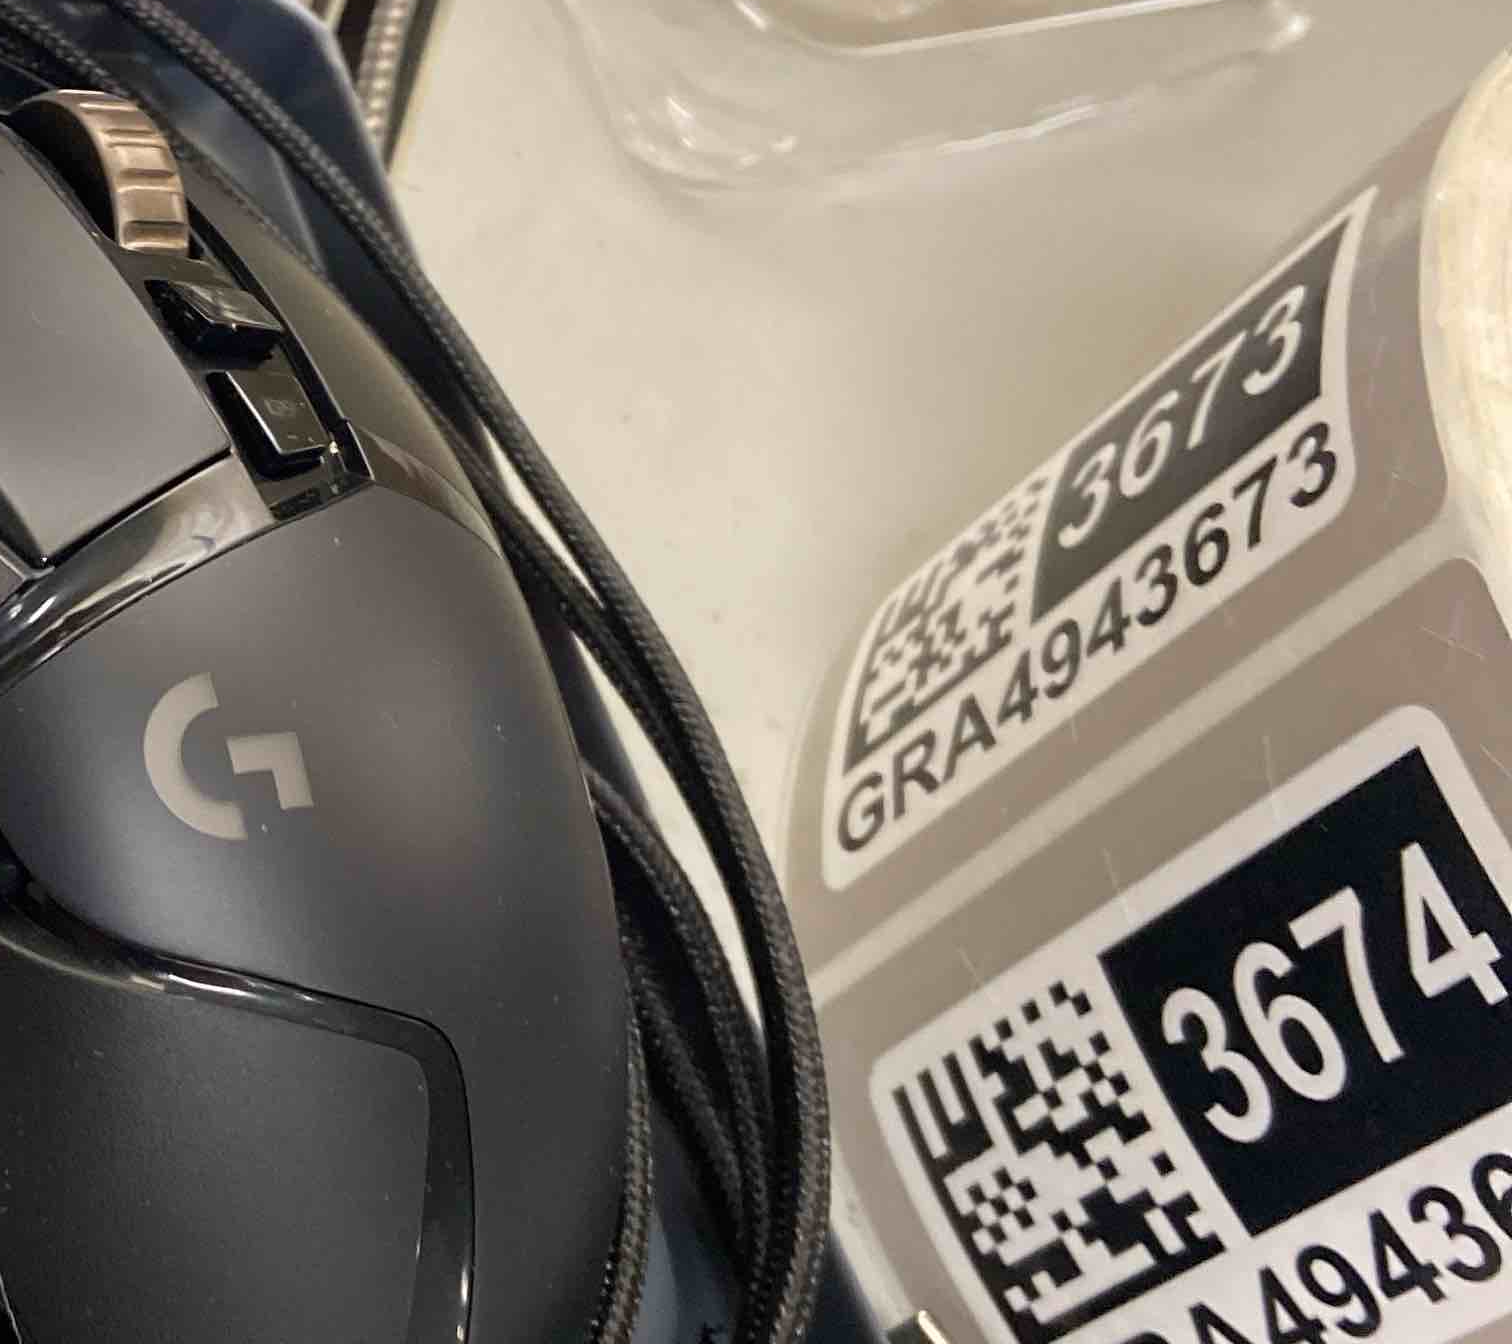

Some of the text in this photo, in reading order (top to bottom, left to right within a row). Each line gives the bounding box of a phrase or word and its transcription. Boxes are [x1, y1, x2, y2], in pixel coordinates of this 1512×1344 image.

[1058, 284, 1306, 549] 3673
[837, 420, 1337, 854] GRA4943673
[1161, 842, 1509, 1144] 3674
